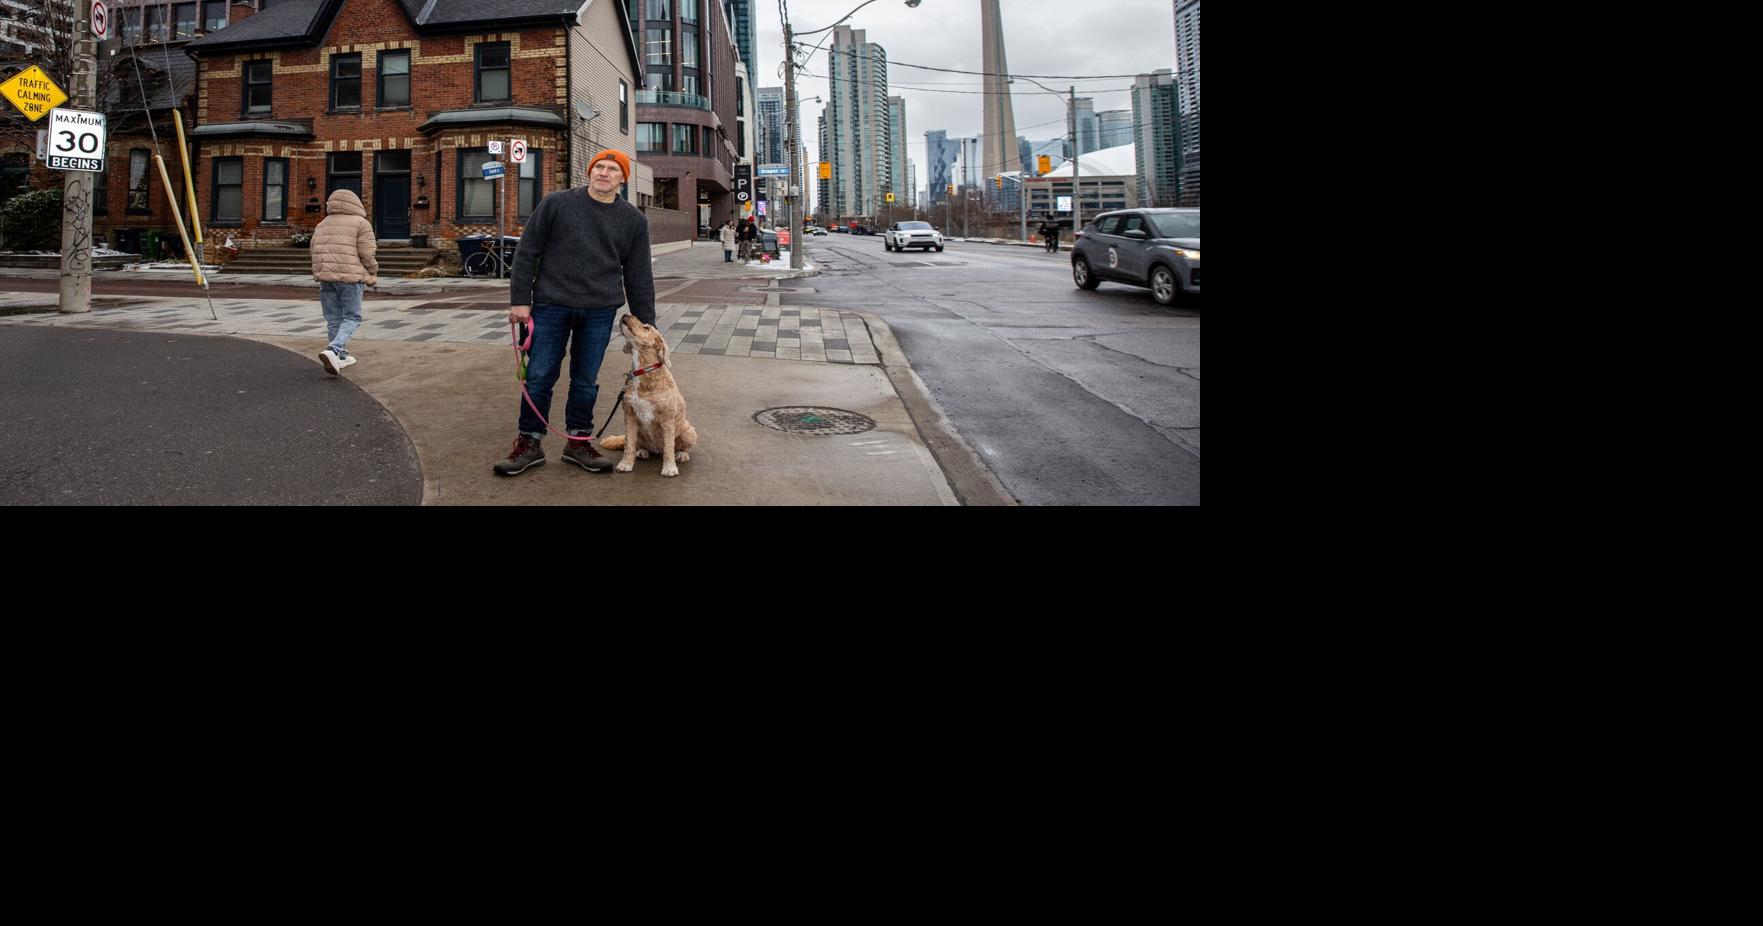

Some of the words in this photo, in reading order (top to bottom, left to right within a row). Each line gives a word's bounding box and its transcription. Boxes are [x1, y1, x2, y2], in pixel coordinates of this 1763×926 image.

[19, 78, 50, 91] TRAFFIC
[17, 90, 51, 102] CALMING
[23, 102, 44, 113] ZONE
[55, 115, 102, 126] MAXIMUM
[55, 130, 99, 154] 30
[52, 157, 99, 170] BEGINS
[738, 179, 747, 189] P
